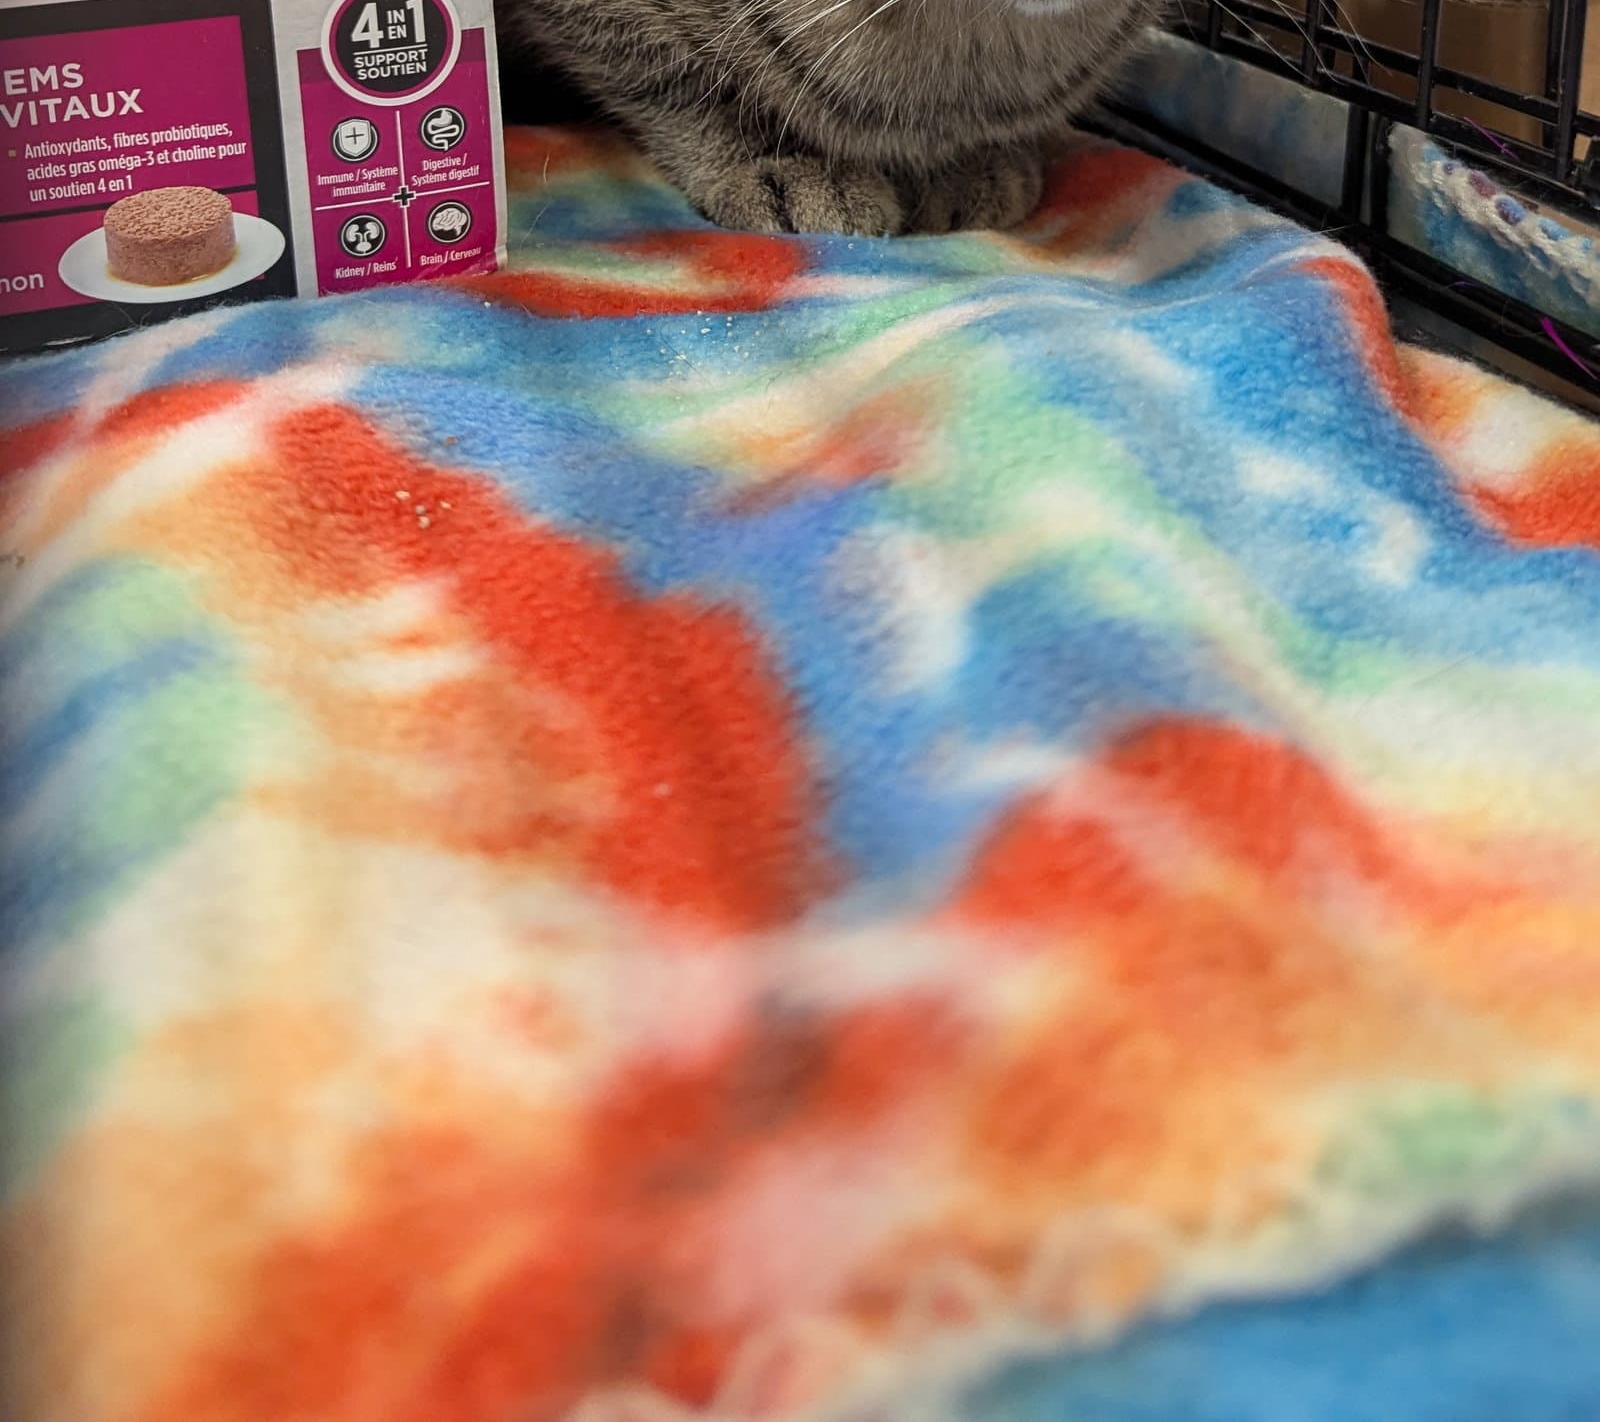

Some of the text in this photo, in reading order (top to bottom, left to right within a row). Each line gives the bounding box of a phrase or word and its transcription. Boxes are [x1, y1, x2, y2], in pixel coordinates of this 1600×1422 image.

[351, 2, 384, 49] 4
[386, 9, 406, 25] IN
[388, 24, 407, 40] EN
[353, 48, 428, 68] SUPPORT
[3, 63, 84, 96] EMS
[357, 61, 427, 81] SOUTIEN
[0, 88, 144, 128] VITAUX
[24, 122, 233, 160] Antioxydants, fibres probiotiques,
[27, 141, 247, 181] acides gras oméga-3 et choline pour
[422, 157, 462, 172] Digestive
[317, 171, 354, 186] Immune
[362, 165, 399, 181] Système
[411, 164, 480, 187] Système digestif
[29, 175, 133, 202] un soutien 4 en 1
[332, 180, 386, 197] immunitaire
[420, 252, 442, 267] Brain
[449, 246, 482, 262] Cerveau
[335, 263, 365, 279] Kidney
[373, 260, 397, 274] Reins
